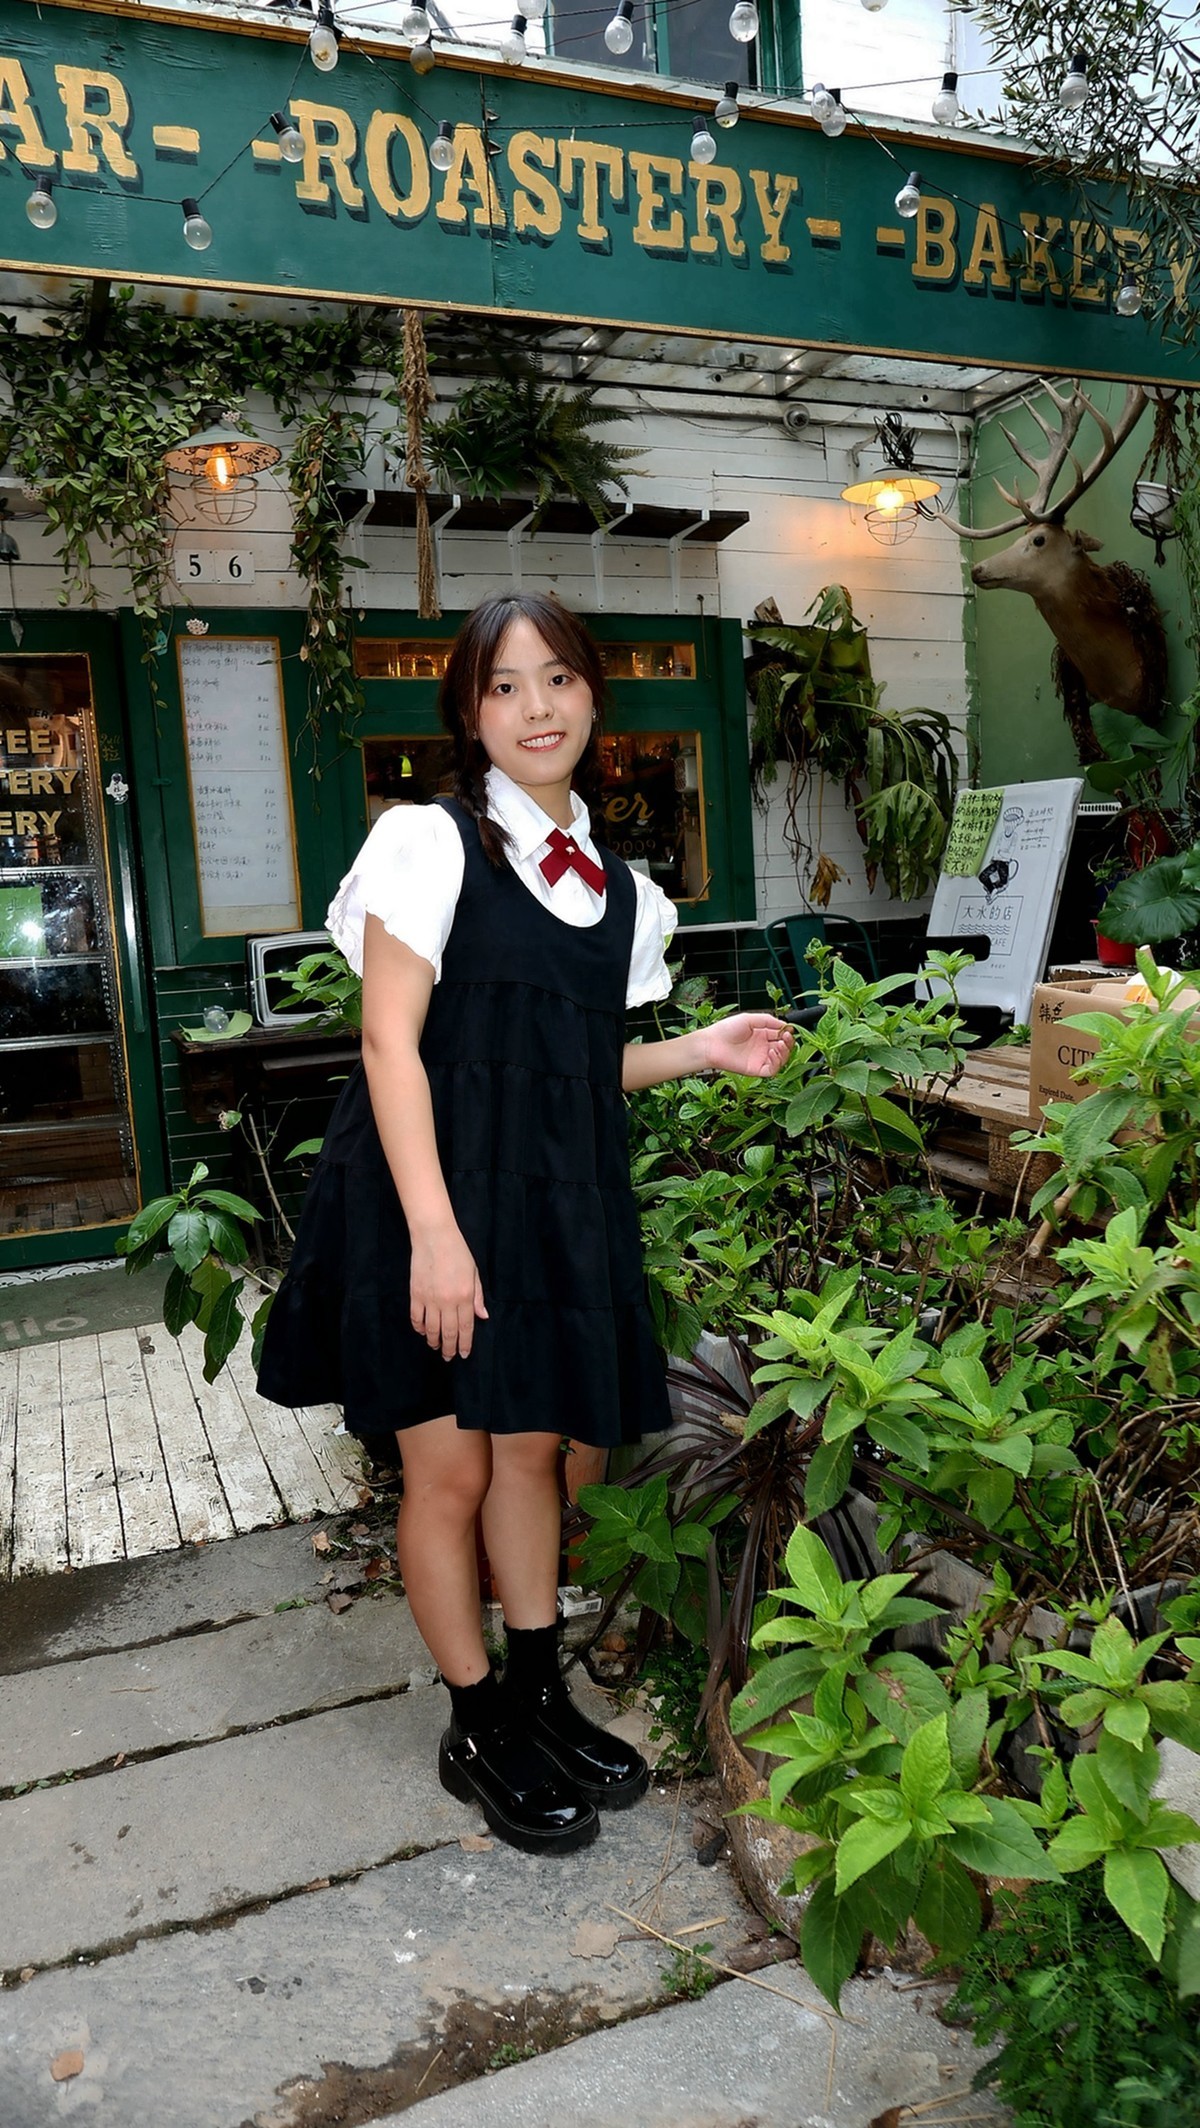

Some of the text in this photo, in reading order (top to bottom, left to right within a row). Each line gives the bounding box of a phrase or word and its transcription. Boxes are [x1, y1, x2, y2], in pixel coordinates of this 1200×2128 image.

[0, 730, 53, 754] EE
[612, 839, 656, 854] 2009
[961, 904, 1014, 921] 大水的店
[1057, 1045, 1096, 1068] CIT
[1039, 1084, 1060, 1098] Expired
